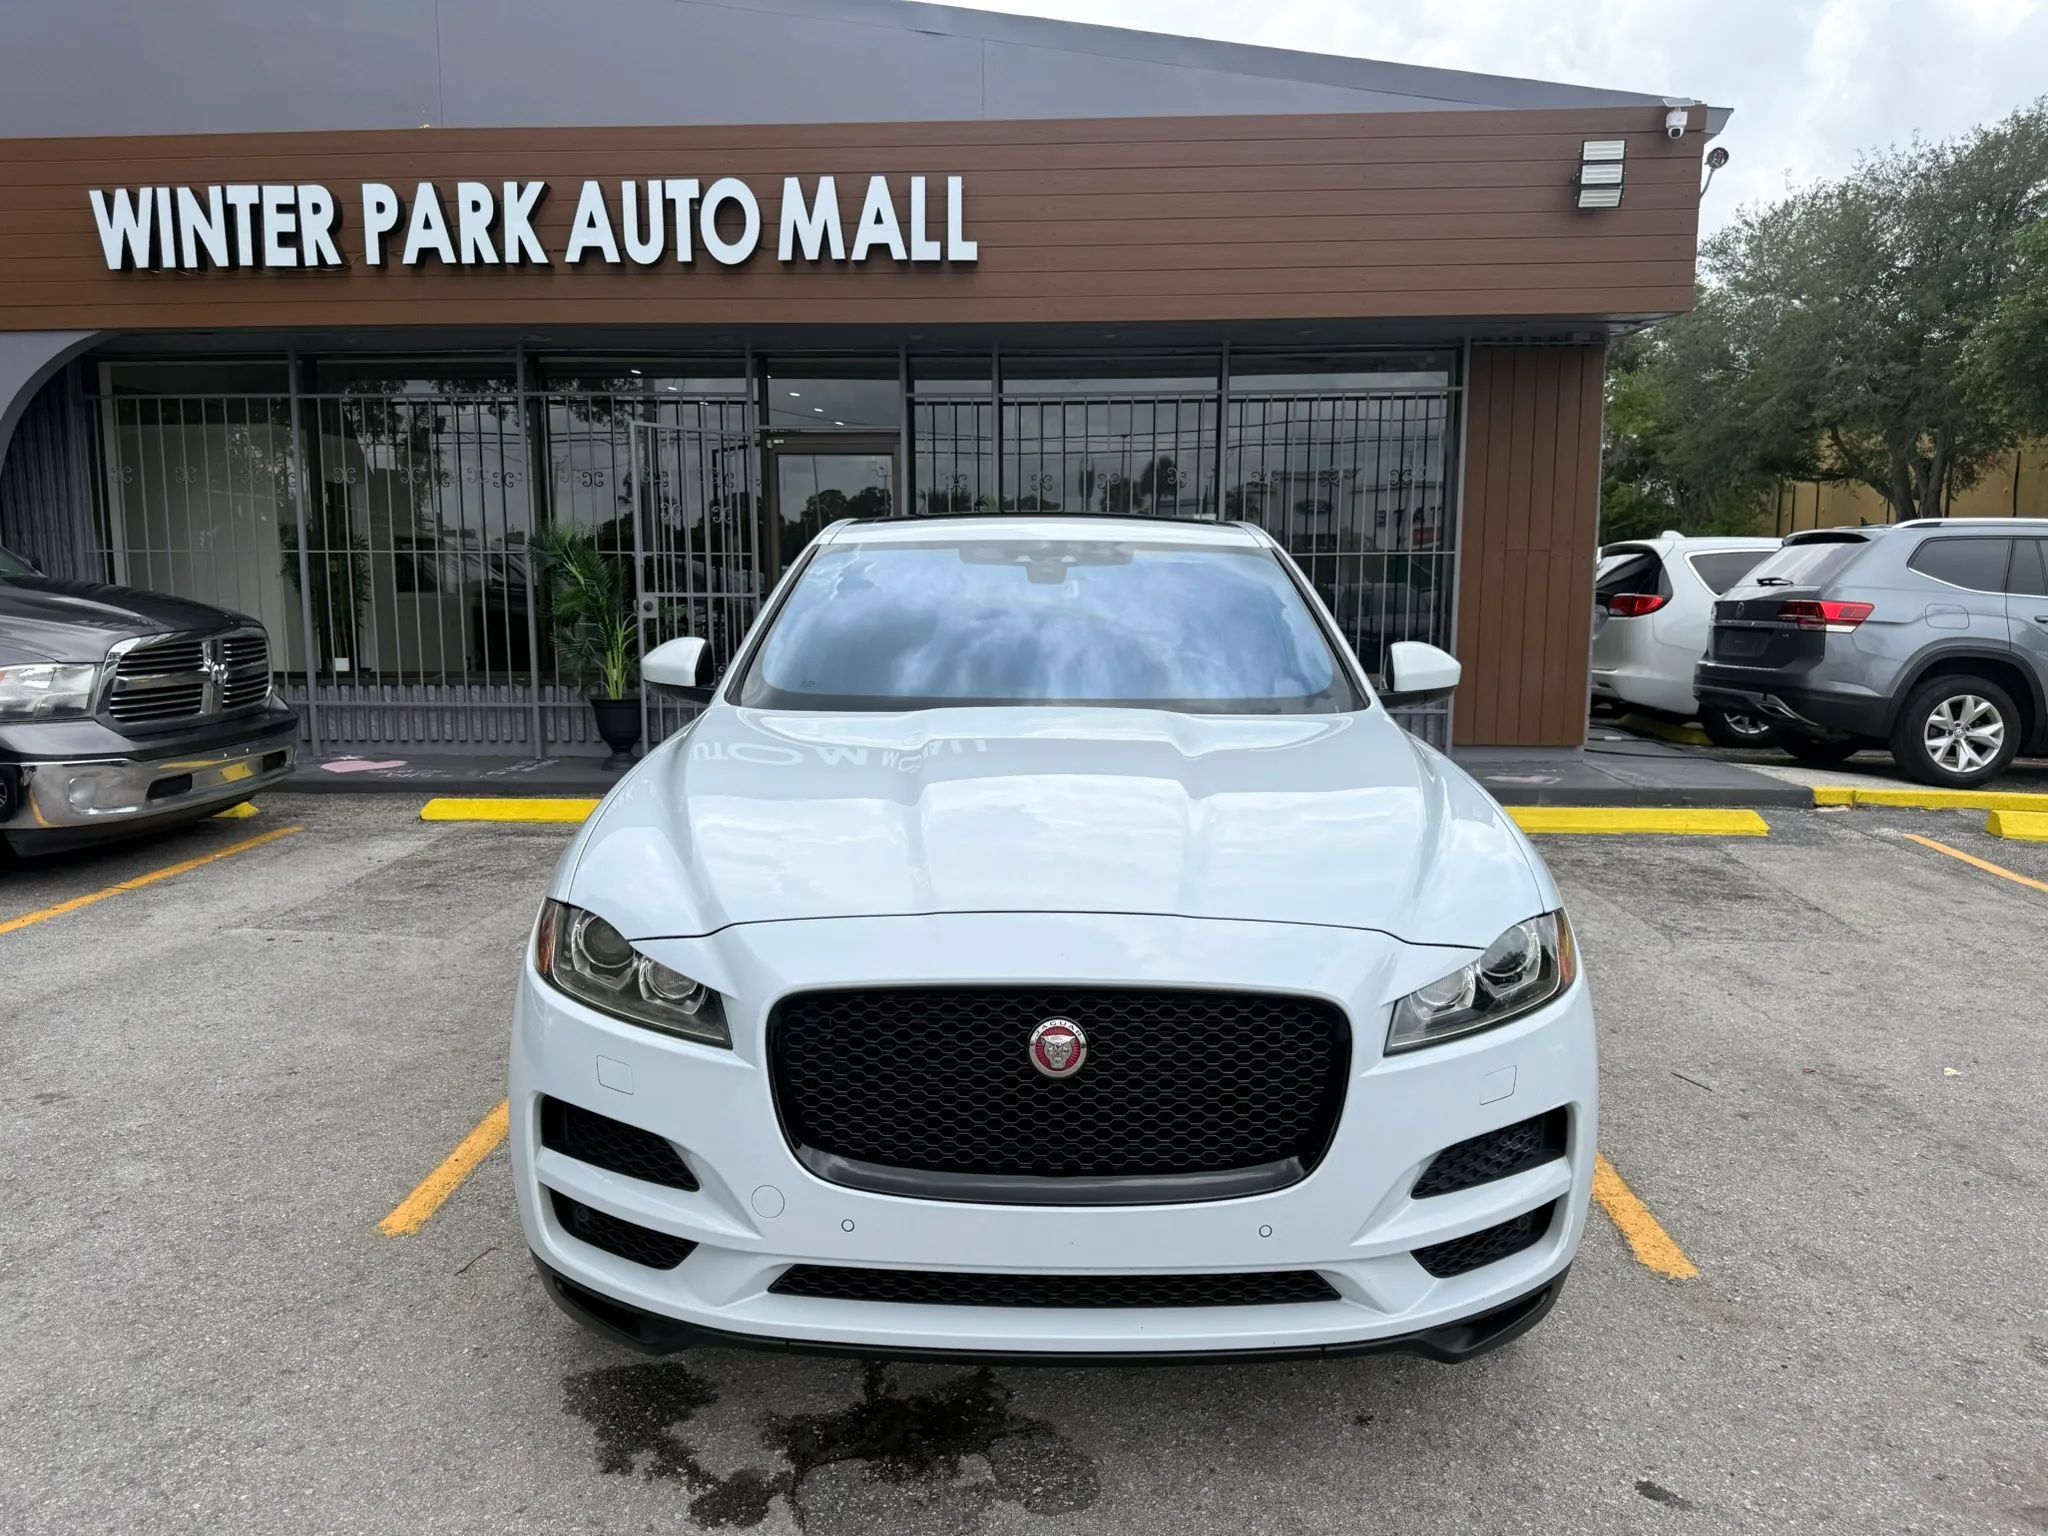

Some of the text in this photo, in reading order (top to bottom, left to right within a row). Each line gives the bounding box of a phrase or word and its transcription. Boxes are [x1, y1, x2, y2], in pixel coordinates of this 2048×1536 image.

[88, 175, 978, 270] WINTER PARK AUTO MALL
[1035, 1021, 1082, 1038] JAGUAR
